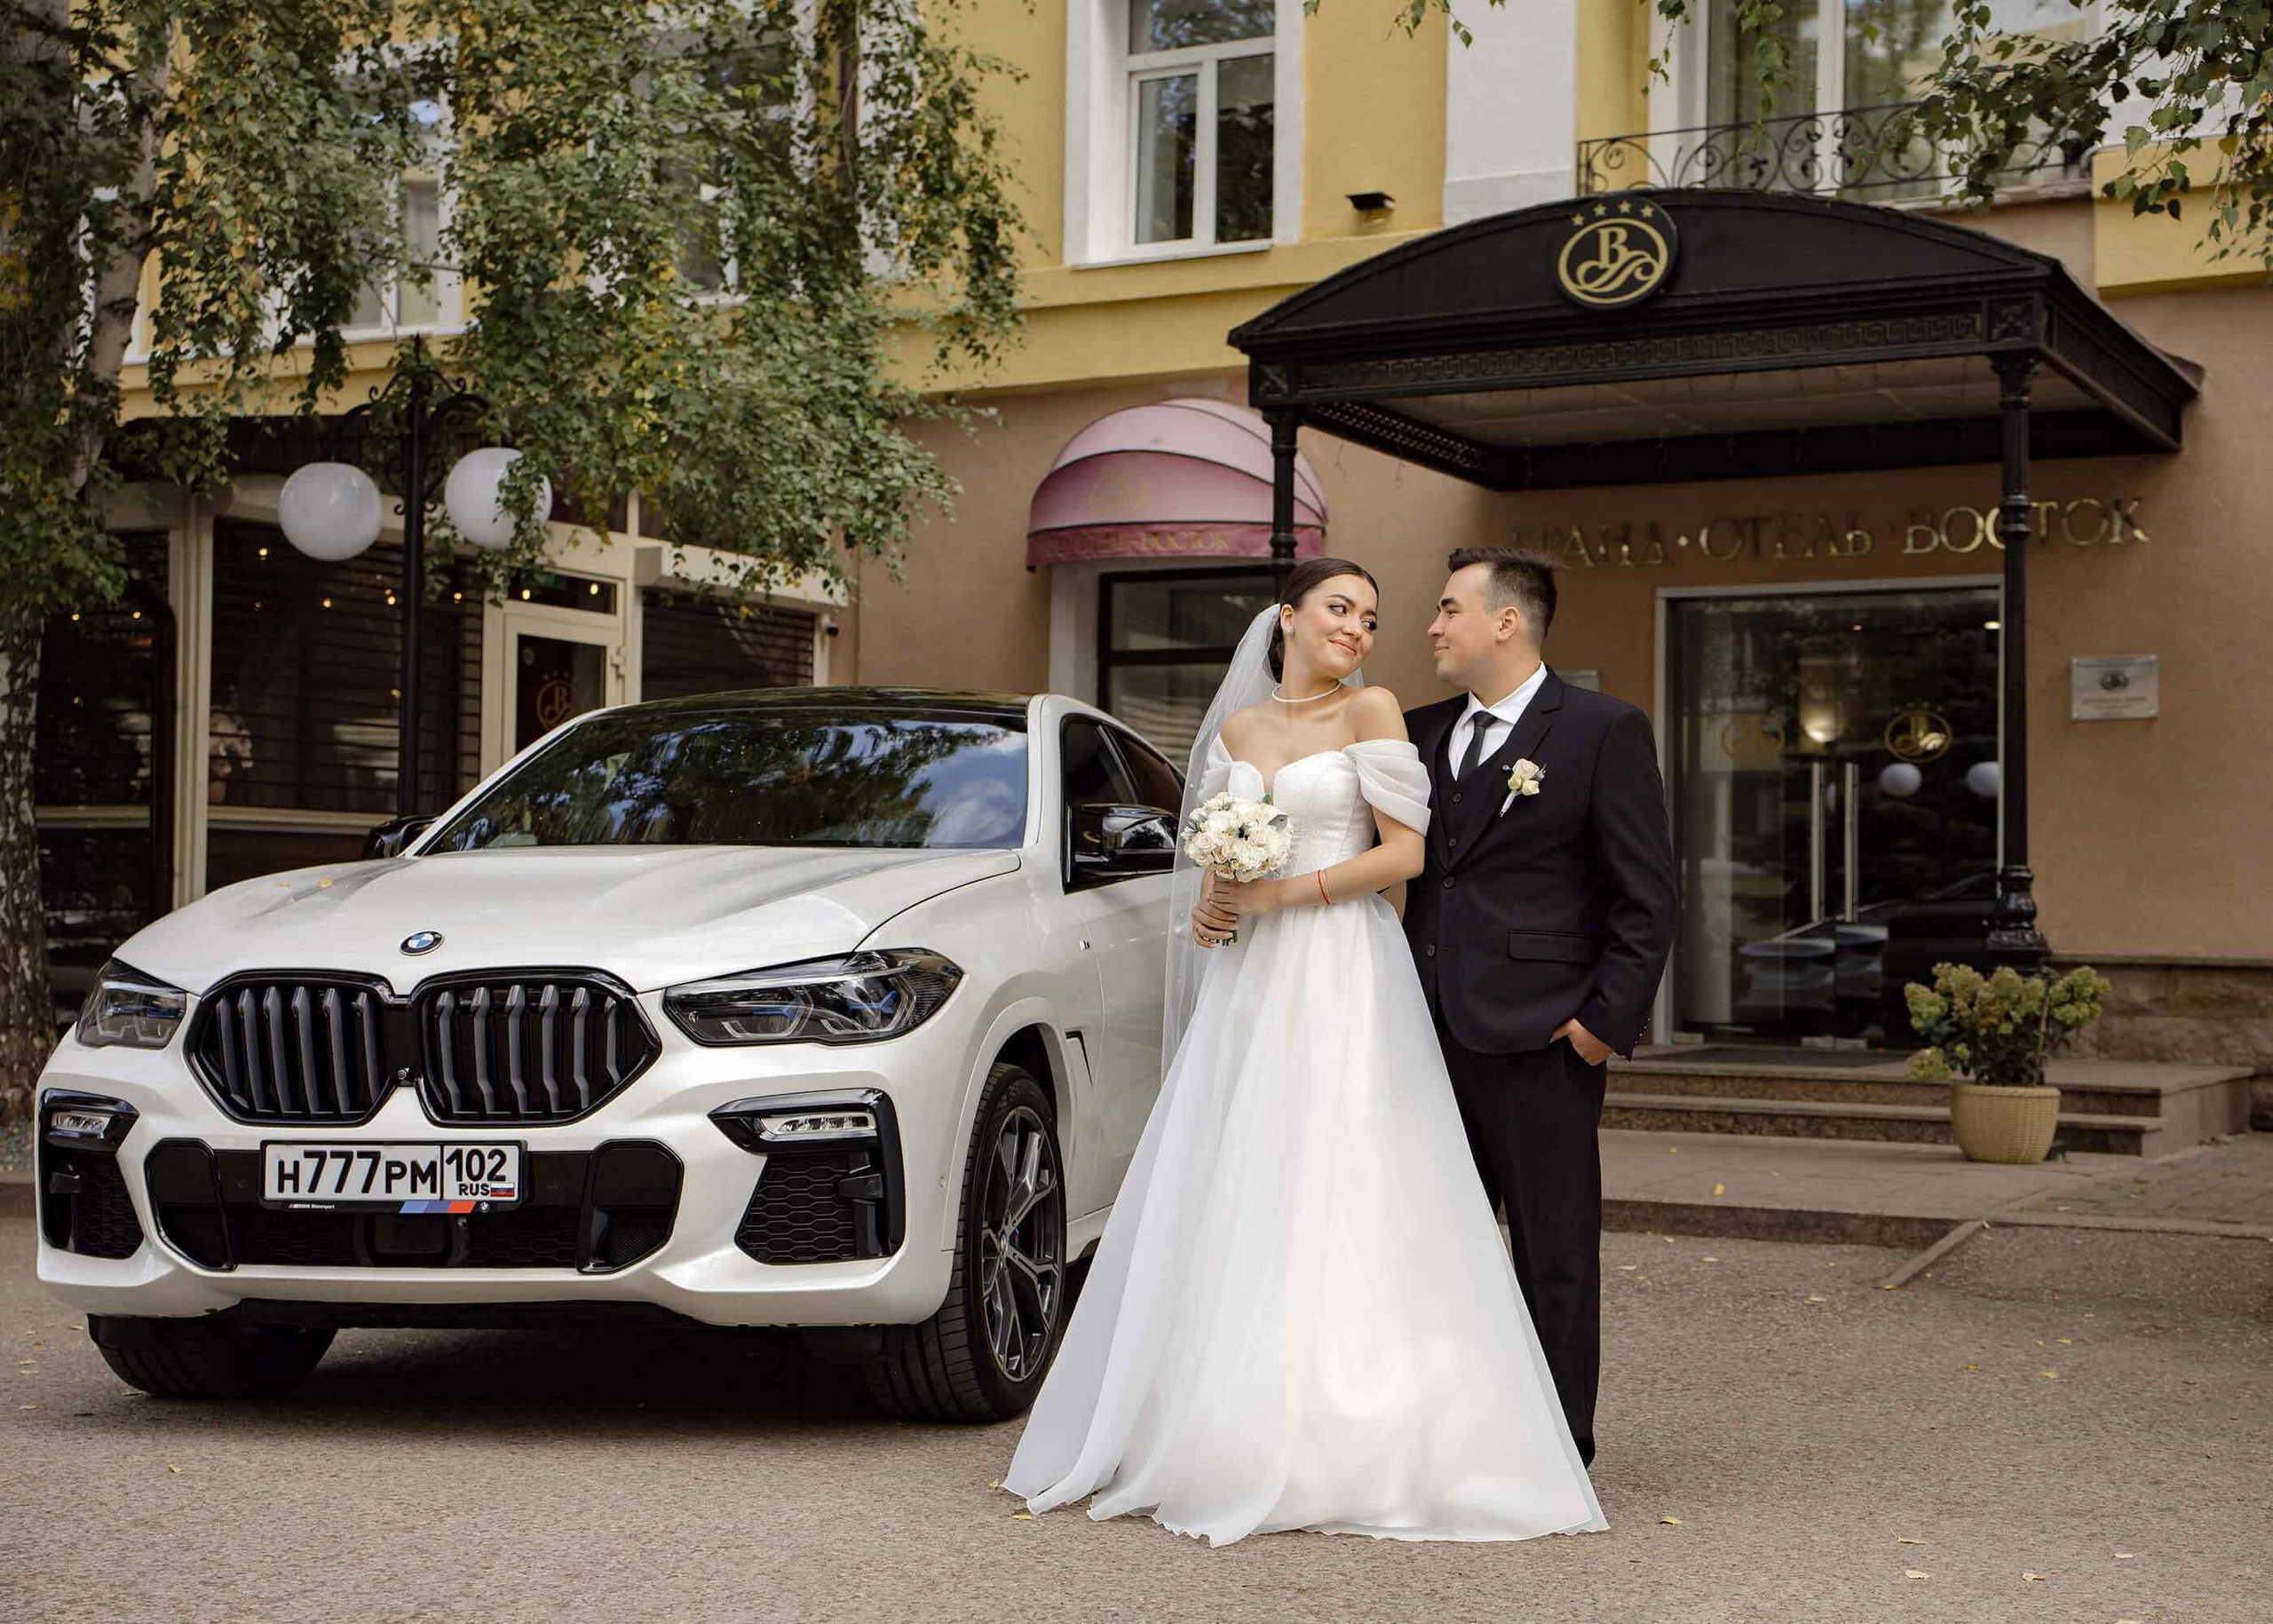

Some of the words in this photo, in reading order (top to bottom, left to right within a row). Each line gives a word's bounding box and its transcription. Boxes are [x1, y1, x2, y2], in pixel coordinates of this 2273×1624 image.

[277, 1149, 438, 1194] Н777РМ
[445, 1148, 507, 1183] 102
[458, 1184, 489, 1196] RUS
